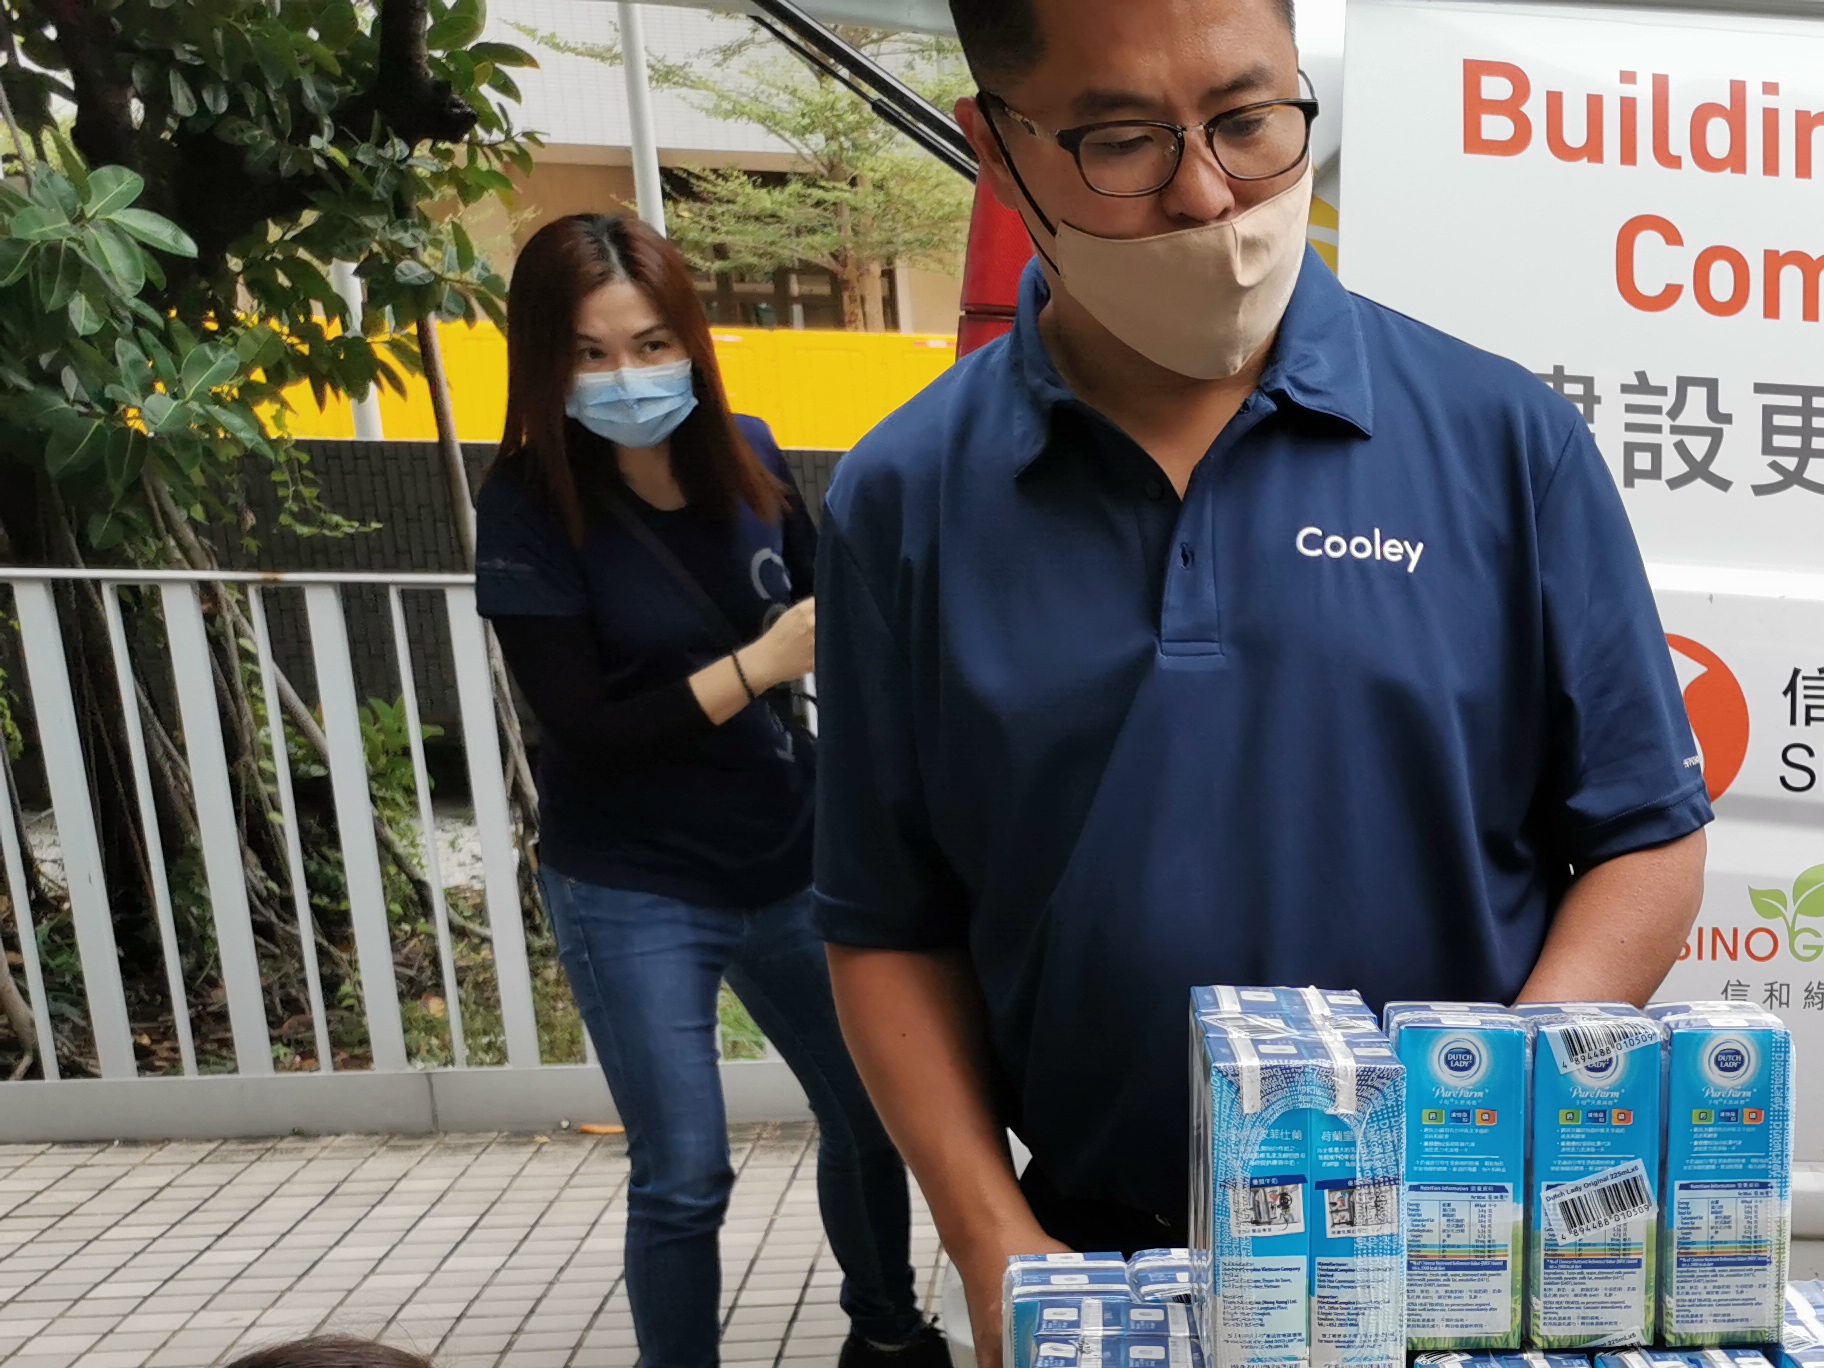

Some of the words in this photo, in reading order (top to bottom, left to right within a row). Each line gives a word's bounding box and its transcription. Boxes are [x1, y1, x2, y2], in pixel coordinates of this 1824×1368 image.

[1295, 525, 1424, 574] Cooley
[1447, 1054, 1473, 1063] DUTCH
[1574, 1047, 1613, 1066] 894488
[1617, 1032, 1655, 1051] 010509
[1717, 1053, 1742, 1062] DUTCH
[1449, 1060, 1471, 1068] LADY
[1720, 1060, 1741, 1068] LADY
[1545, 1189, 1566, 1203] Dutch
[1566, 1184, 1583, 1199] Lady
[1583, 1174, 1609, 1192] Original
[1561, 1234, 1567, 1242] 4
[1573, 1217, 1611, 1237] 894488
[1613, 1203, 1650, 1224] 010509
